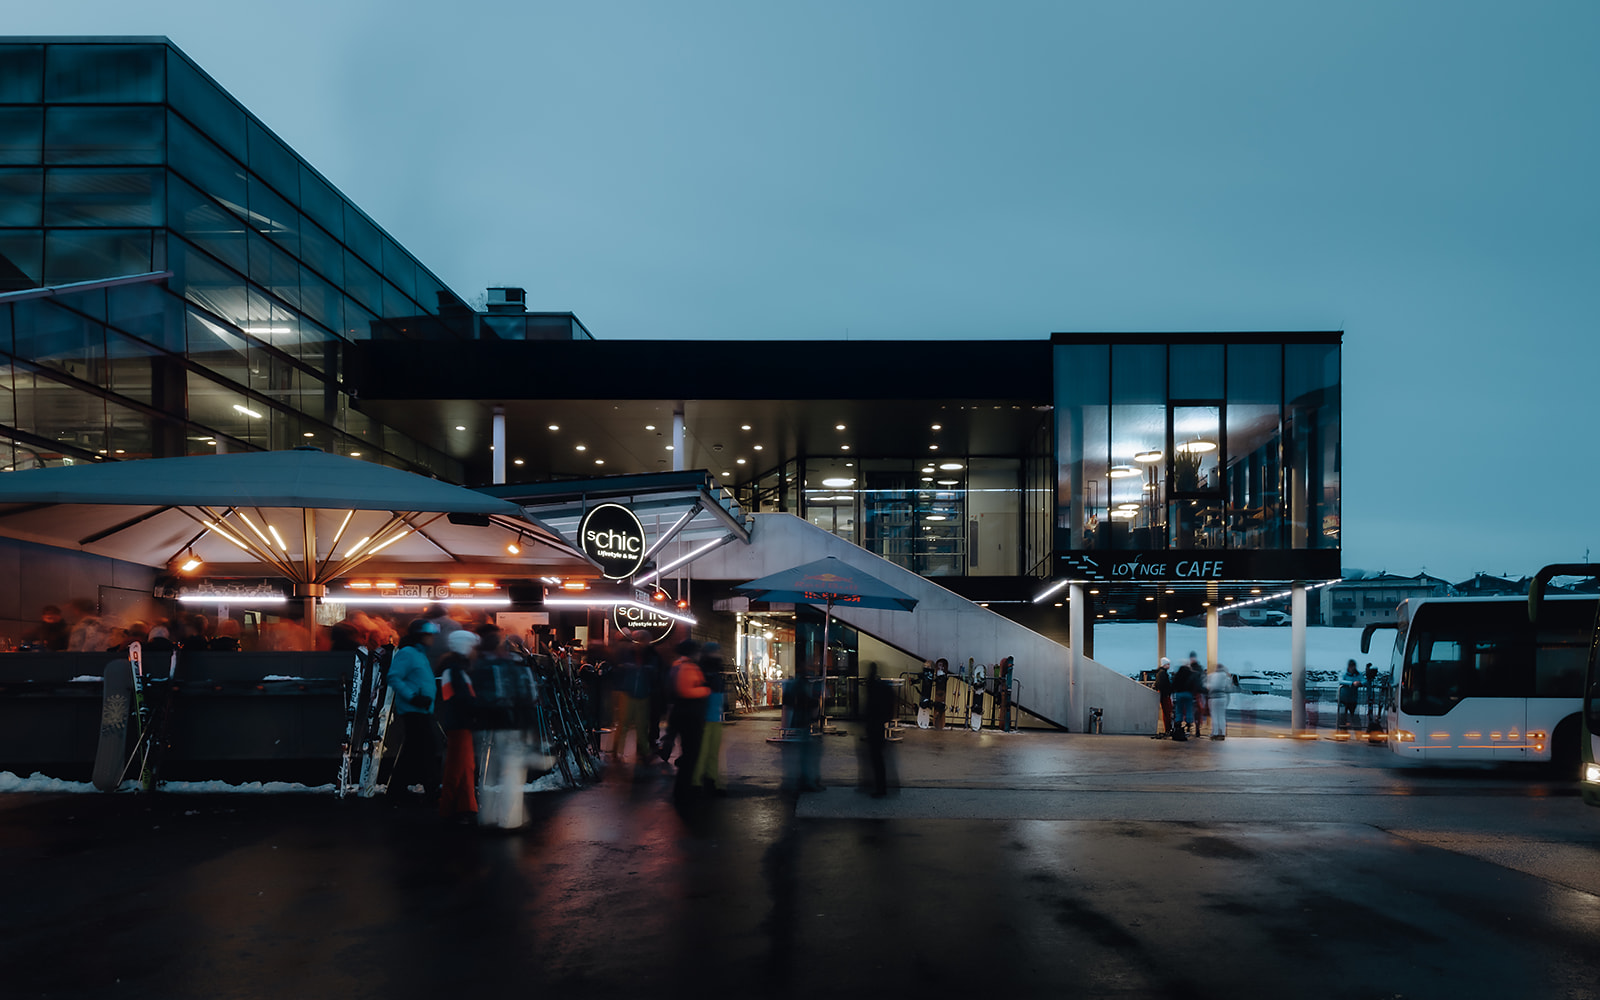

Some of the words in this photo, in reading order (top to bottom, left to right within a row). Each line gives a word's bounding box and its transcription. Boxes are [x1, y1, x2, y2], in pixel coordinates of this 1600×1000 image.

[587, 529, 640, 552] schic
[598, 550, 622, 558] Lifestyle
[1175, 560, 1224, 577] CAFE
[351, 666, 360, 703] FISCHER
